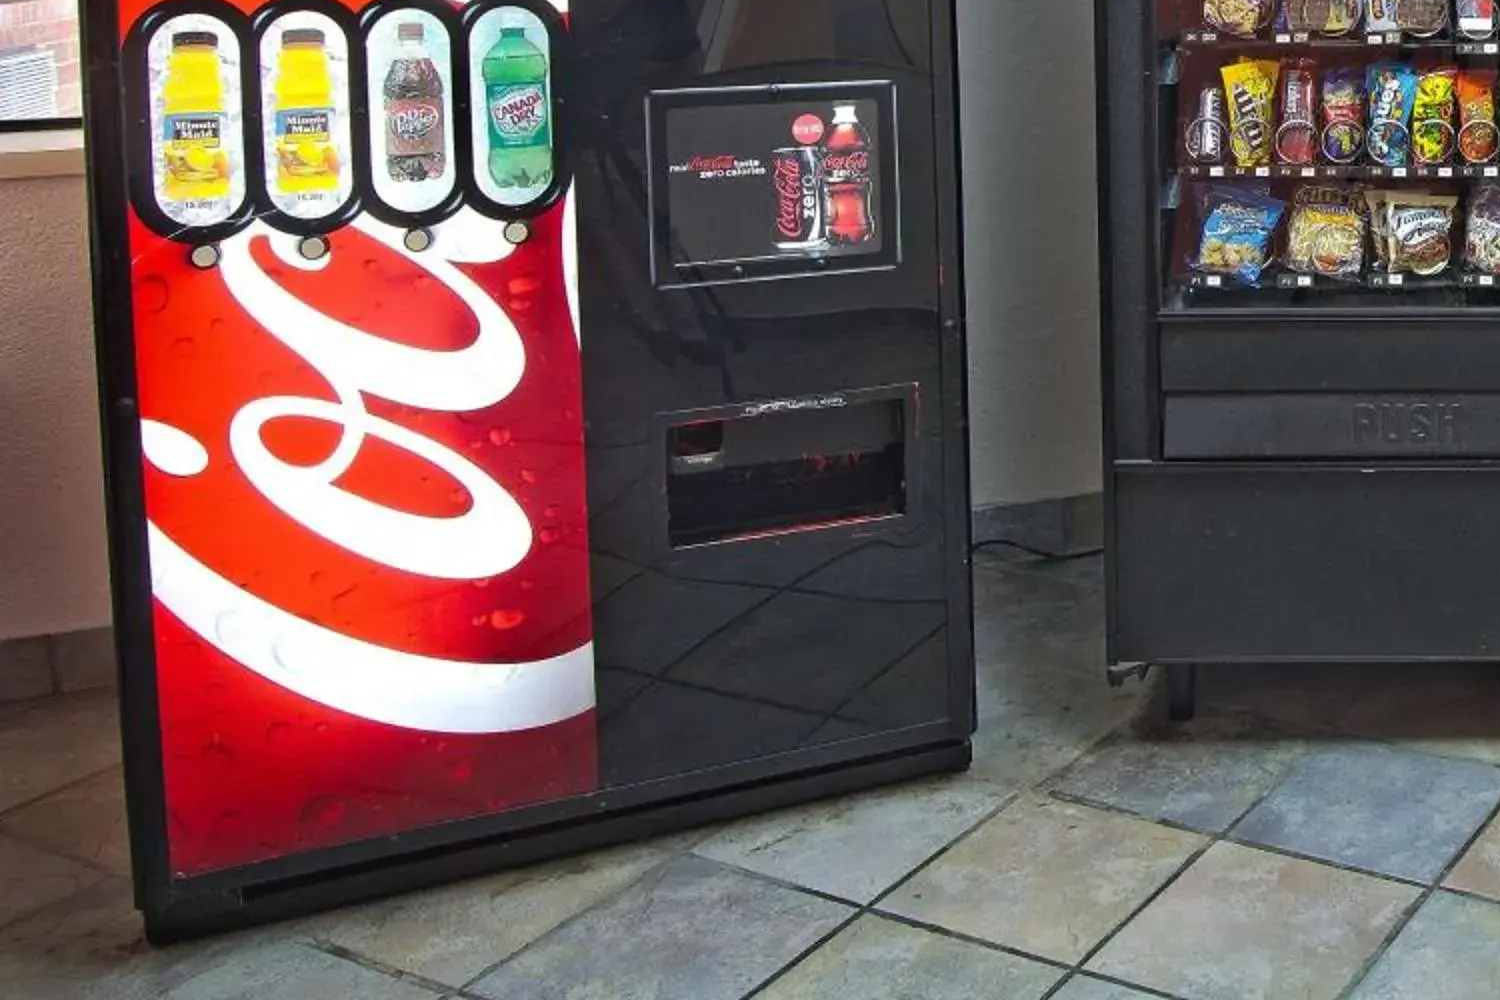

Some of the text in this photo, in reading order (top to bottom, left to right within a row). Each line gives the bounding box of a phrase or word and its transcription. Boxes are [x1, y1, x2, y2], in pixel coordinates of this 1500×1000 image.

[492, 92, 543, 122] CANADA
[509, 108, 537, 126] DRY
[802, 174, 817, 219] zero
